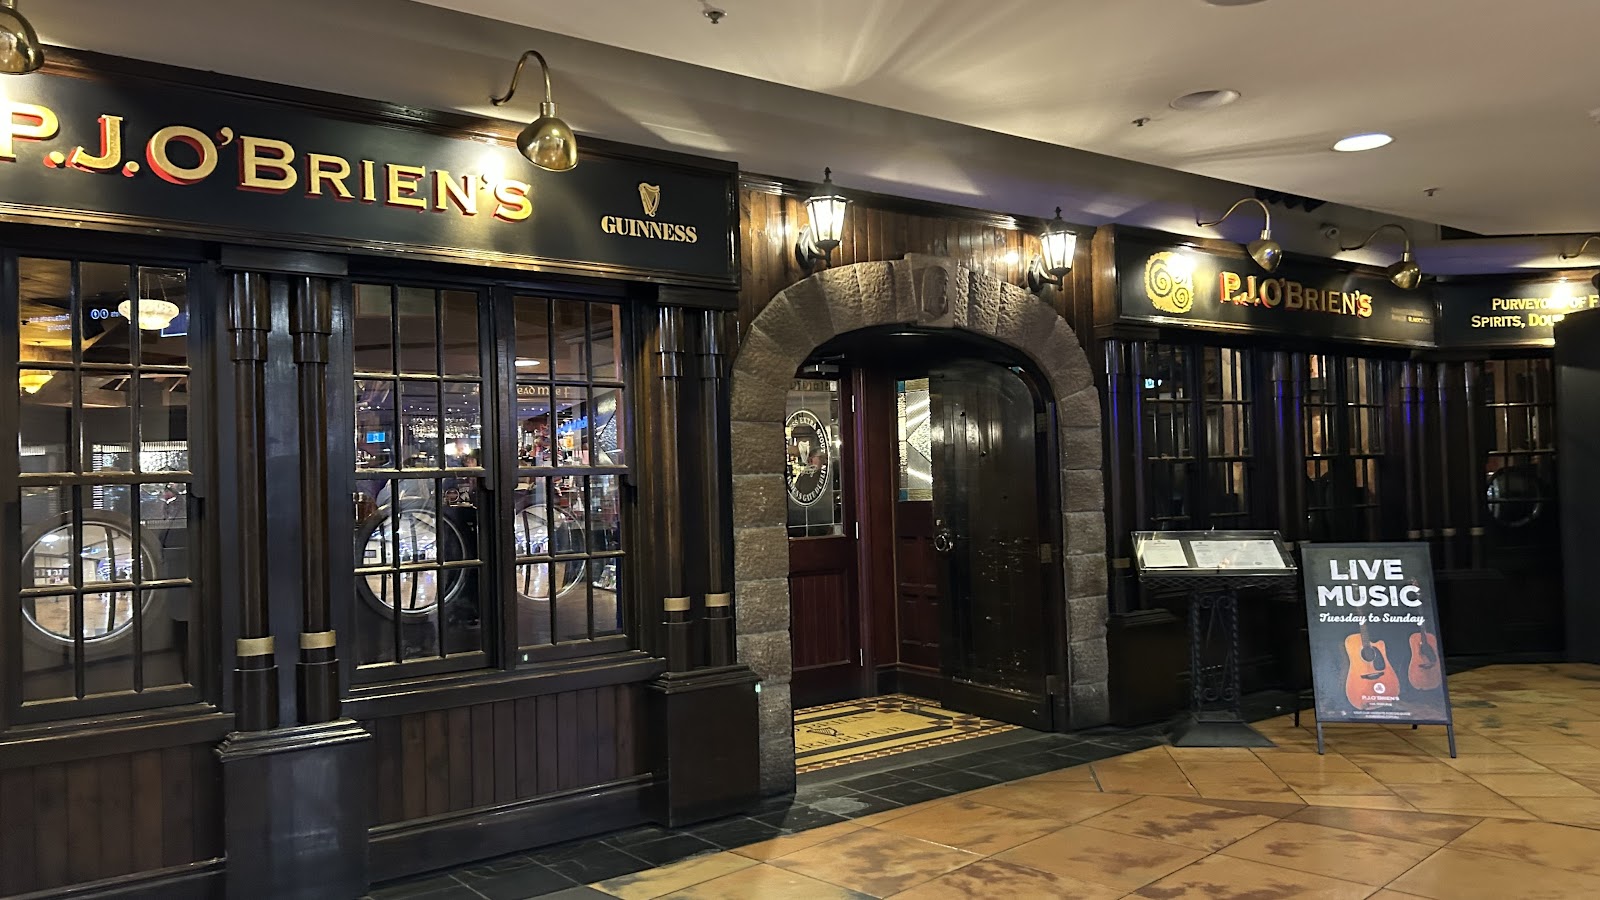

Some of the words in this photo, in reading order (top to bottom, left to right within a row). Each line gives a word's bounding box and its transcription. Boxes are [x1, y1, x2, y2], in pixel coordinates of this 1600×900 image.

[601, 215, 698, 244] GUINNESS
[1492, 298, 1567, 310] PURVEYO
[1571, 296, 1587, 309] OF
[1471, 315, 1526, 329] SPIRITS,
[816, 428, 826, 454] STOUT
[1329, 559, 1404, 580] LIVE
[1317, 585, 1423, 607] MUSIC
[1319, 612, 1367, 626] Tuesday
[1368, 612, 1382, 623] to
[1382, 612, 1426, 626] Sunday
